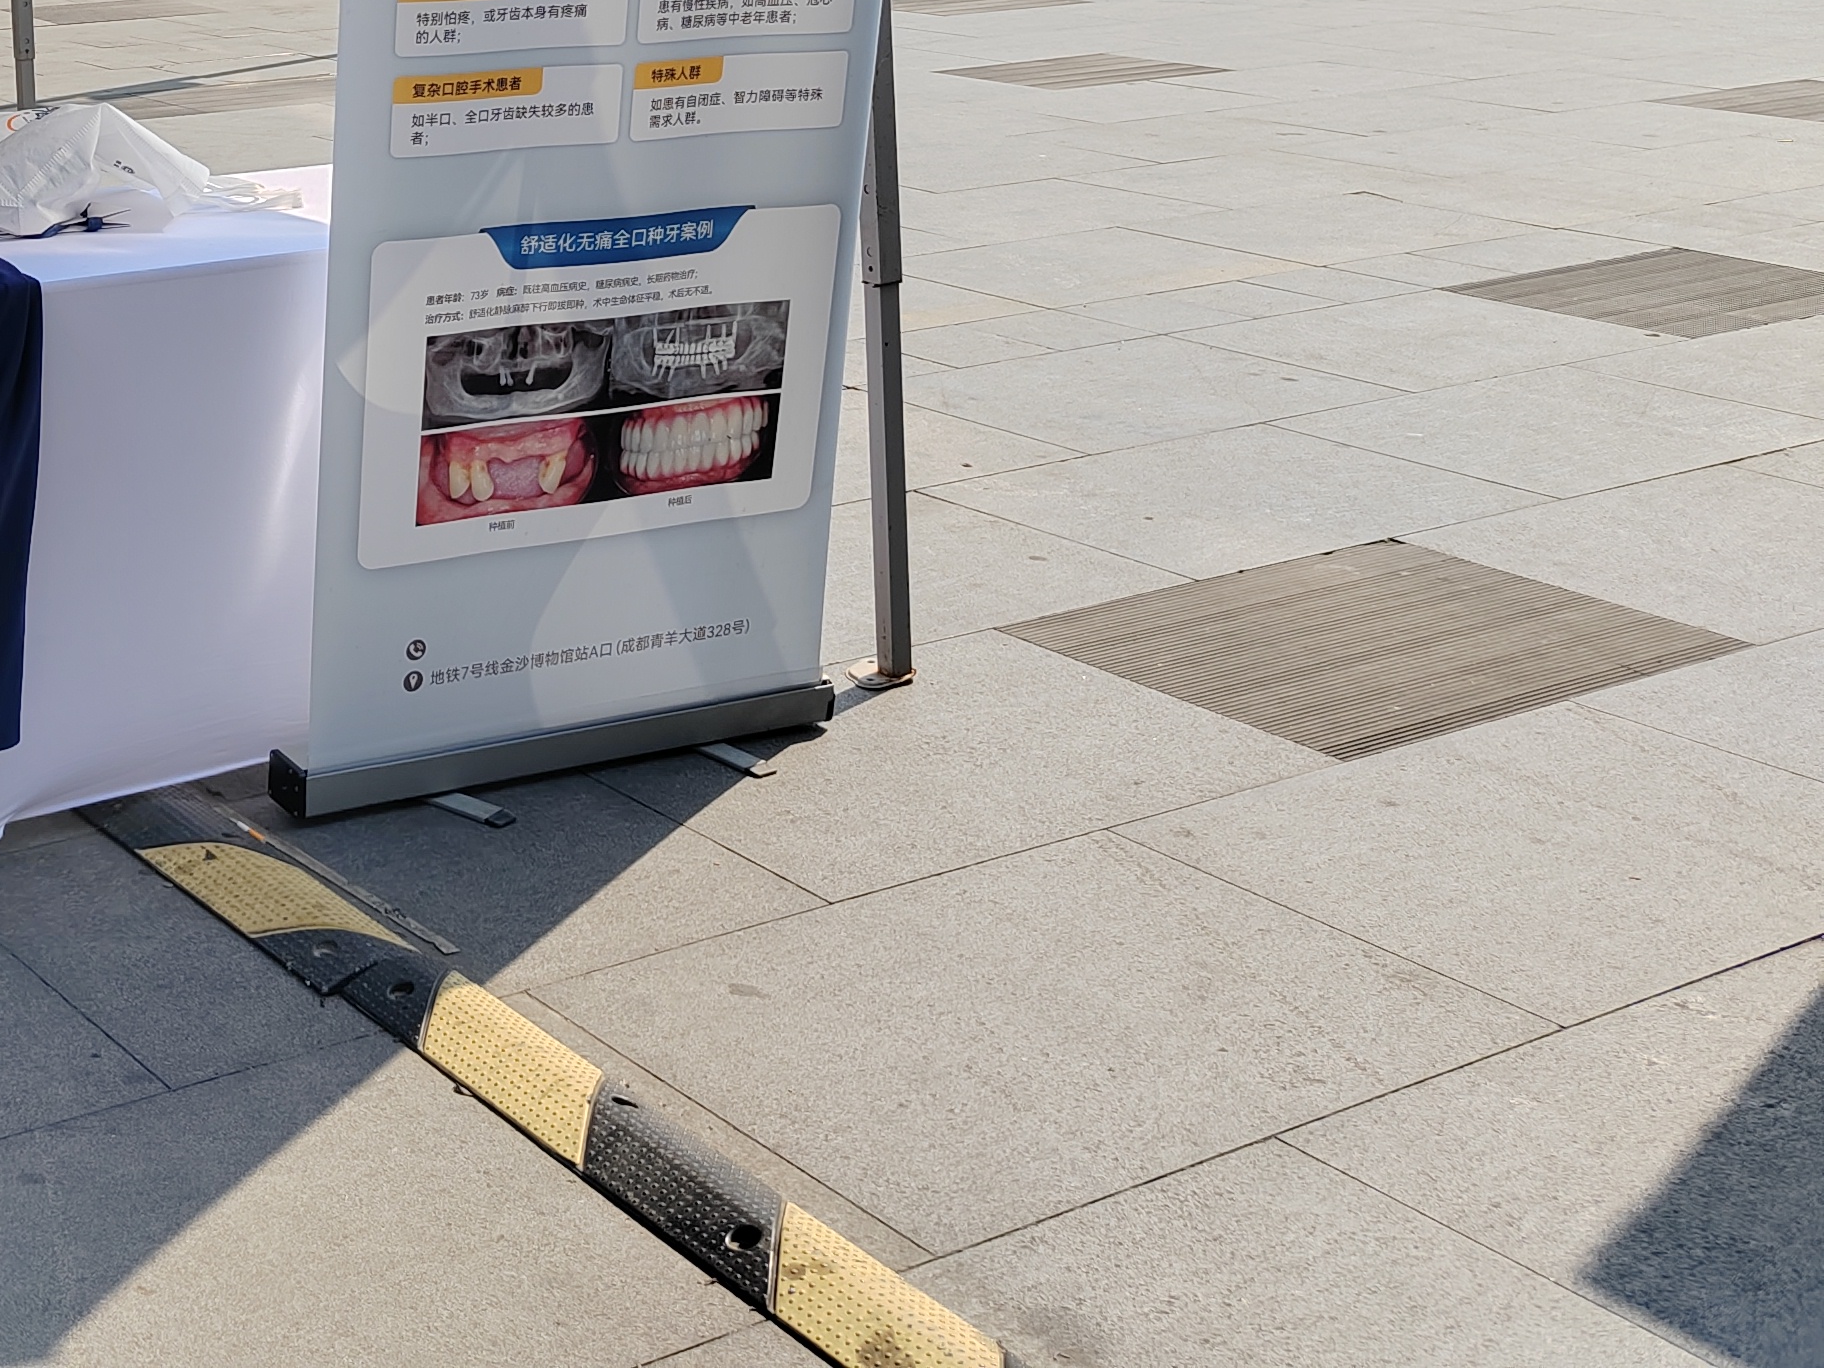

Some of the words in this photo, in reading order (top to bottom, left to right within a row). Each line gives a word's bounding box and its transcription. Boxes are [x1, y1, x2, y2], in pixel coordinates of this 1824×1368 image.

[412, 76, 522, 99] 复杂口腔手术患者
[651, 65, 702, 83] 特殊人群
[520, 219, 715, 256] 舒适化无痛全口种牙案例
[429, 641, 613, 687] 地铁7号线金沙博物馆站A口
[616, 617, 752, 657] (成都青羊大道328号)
